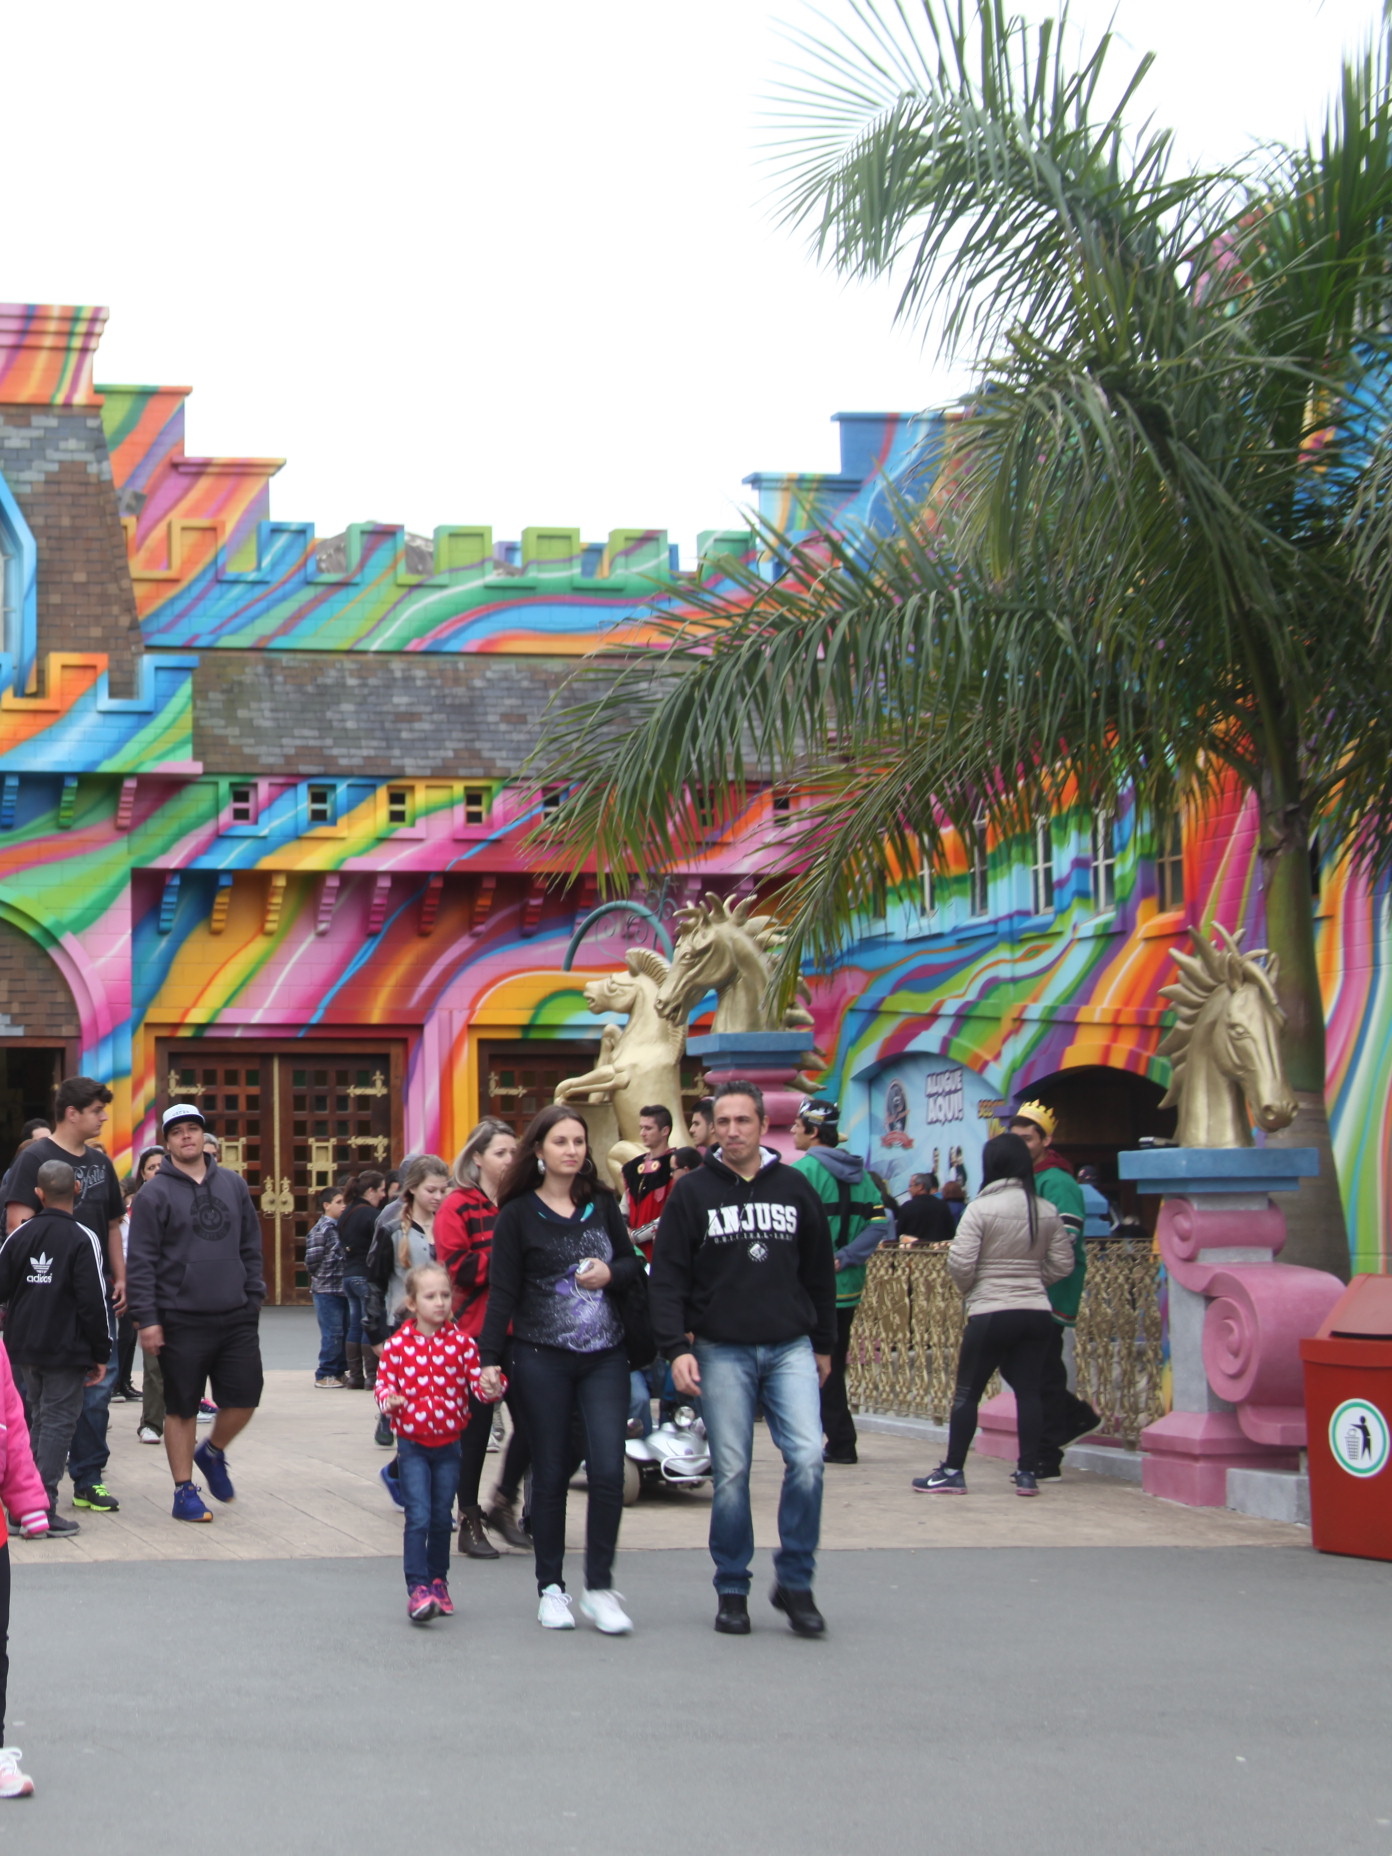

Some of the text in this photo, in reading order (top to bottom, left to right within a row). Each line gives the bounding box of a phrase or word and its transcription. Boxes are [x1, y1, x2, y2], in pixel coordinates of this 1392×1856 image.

[927, 1067, 963, 1097] ALUGUE
[927, 1090, 964, 1126] AQUI!
[707, 1203, 798, 1237] ANJUSS
